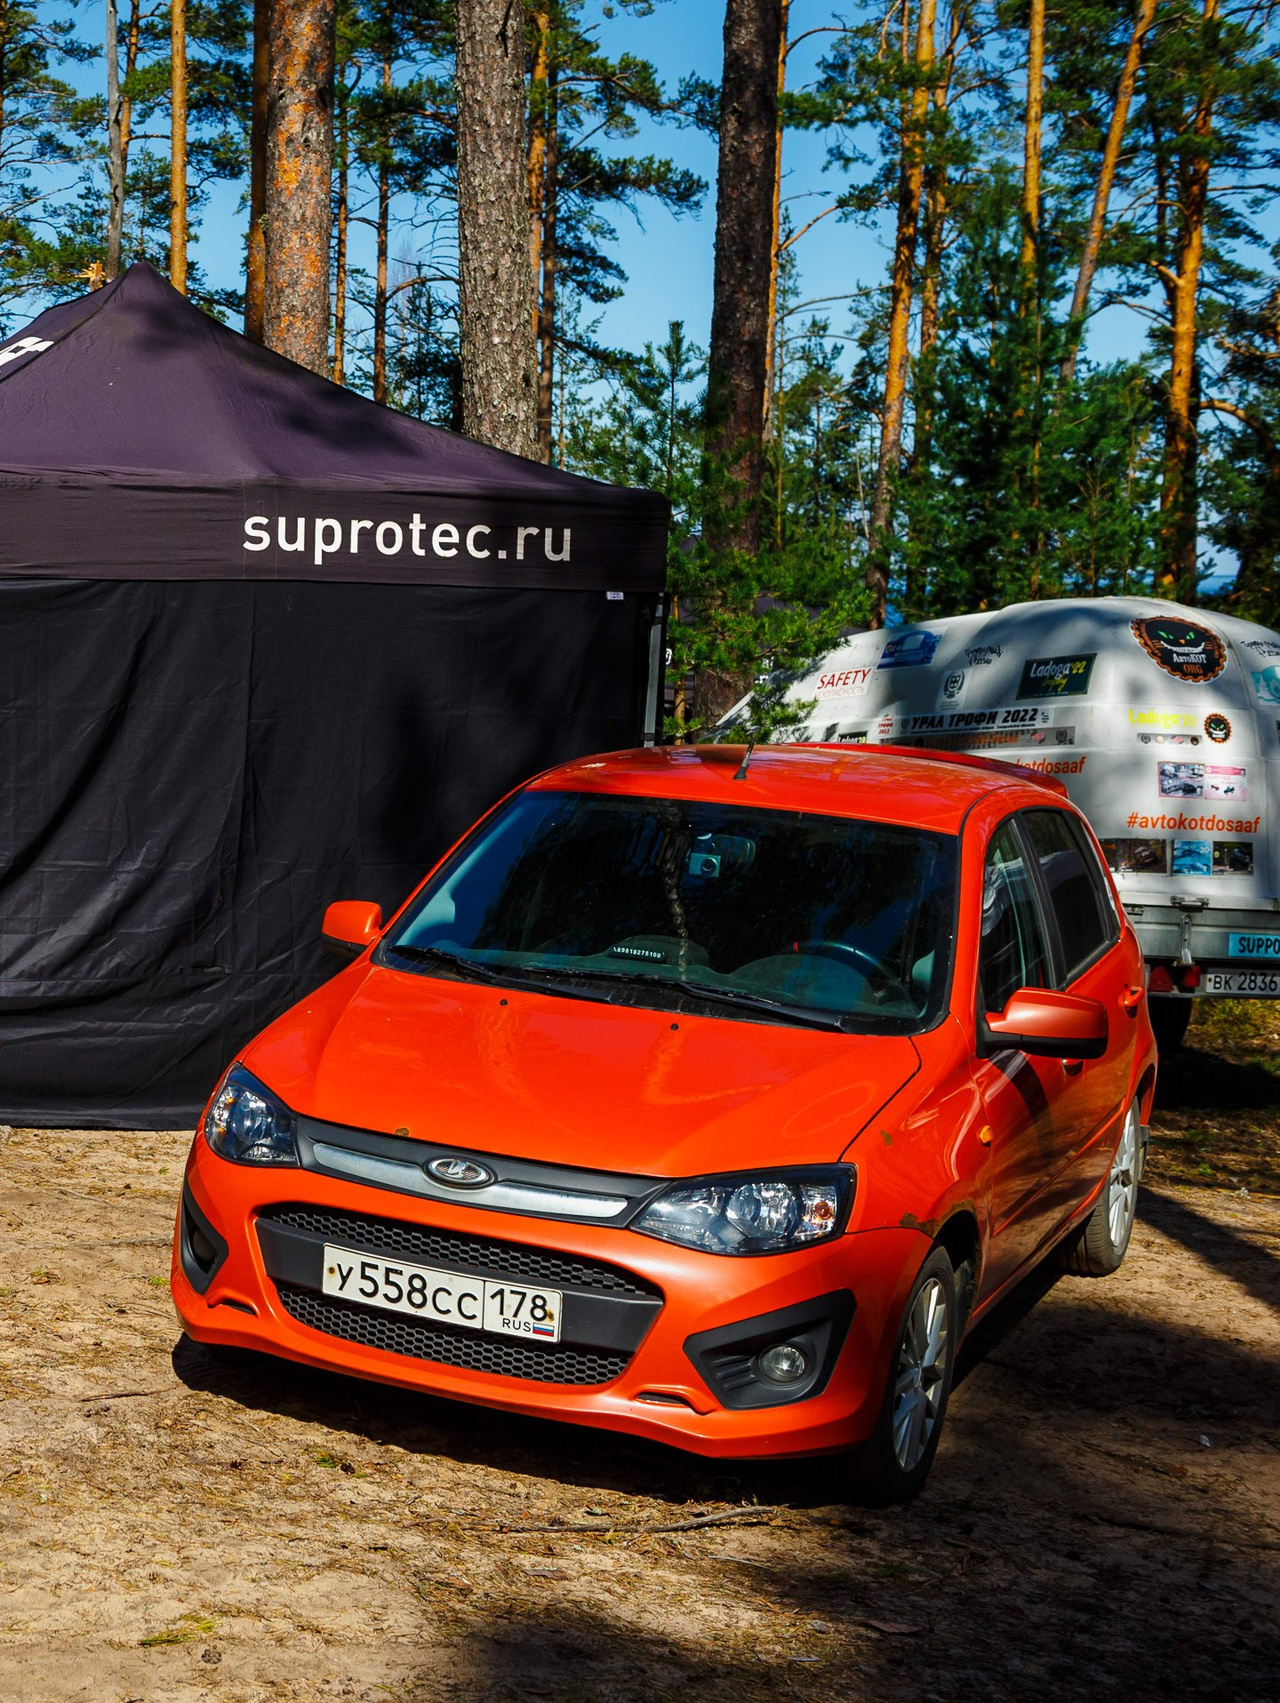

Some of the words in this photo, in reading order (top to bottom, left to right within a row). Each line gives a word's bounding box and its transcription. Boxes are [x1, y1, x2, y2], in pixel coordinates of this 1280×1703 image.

[242, 513, 571, 565] suprotec.ru
[817, 668, 872, 690] SAFETY
[1183, 664, 1204, 674] ORG
[911, 715, 945, 729] УРАЛ
[948, 711, 999, 727] ТРОФИ
[1002, 708, 1038, 723] 2022
[1126, 812, 1261, 833] #avtokotdosaaf
[1237, 972, 1278, 992] 2836
[490, 1287, 549, 1322] 178
[502, 1318, 532, 1333] RUS
